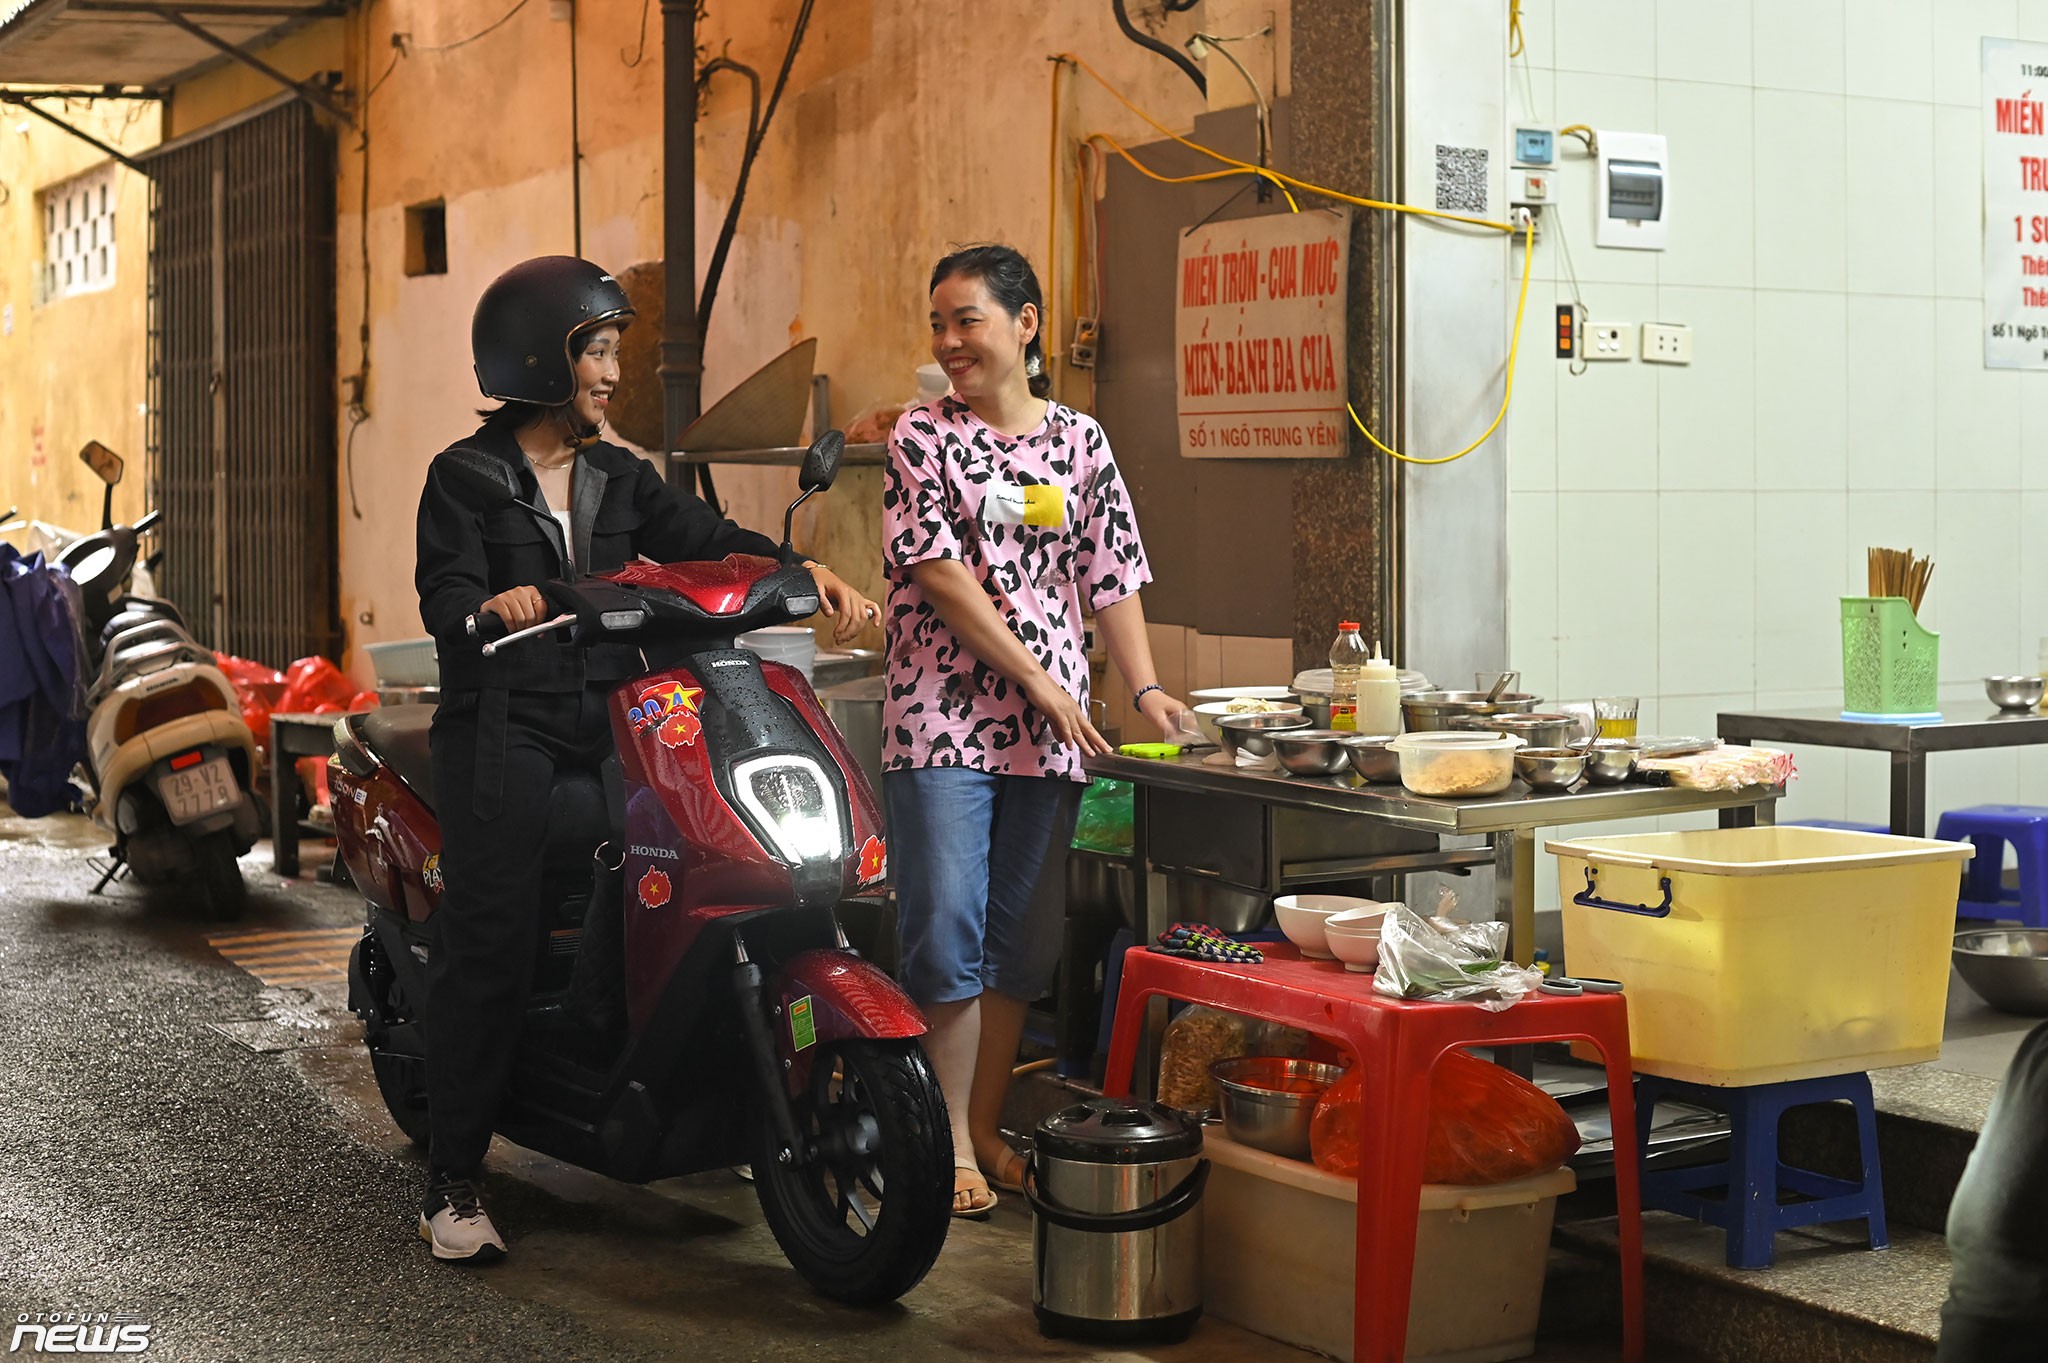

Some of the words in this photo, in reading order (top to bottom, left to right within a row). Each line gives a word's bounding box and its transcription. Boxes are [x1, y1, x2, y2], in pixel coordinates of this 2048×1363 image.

[1996, 89, 2044, 136] MIẾN
[2014, 215, 2022, 243] 1
[1182, 238, 1219, 308] MIẾN
[1268, 245, 1297, 300] CUA
[1273, 336, 1297, 394] ĐA
[1300, 334, 1337, 392] CUA
[1188, 420, 1207, 448] SỐ
[1209, 430, 1216, 447] 1
[1220, 423, 1251, 448] NGÕ
[1253, 426, 1303, 447] TRUNG
[1306, 420, 1337, 447] YÊN
[710, 659, 750, 668] HONDA
[629, 844, 680, 861] HONDA
